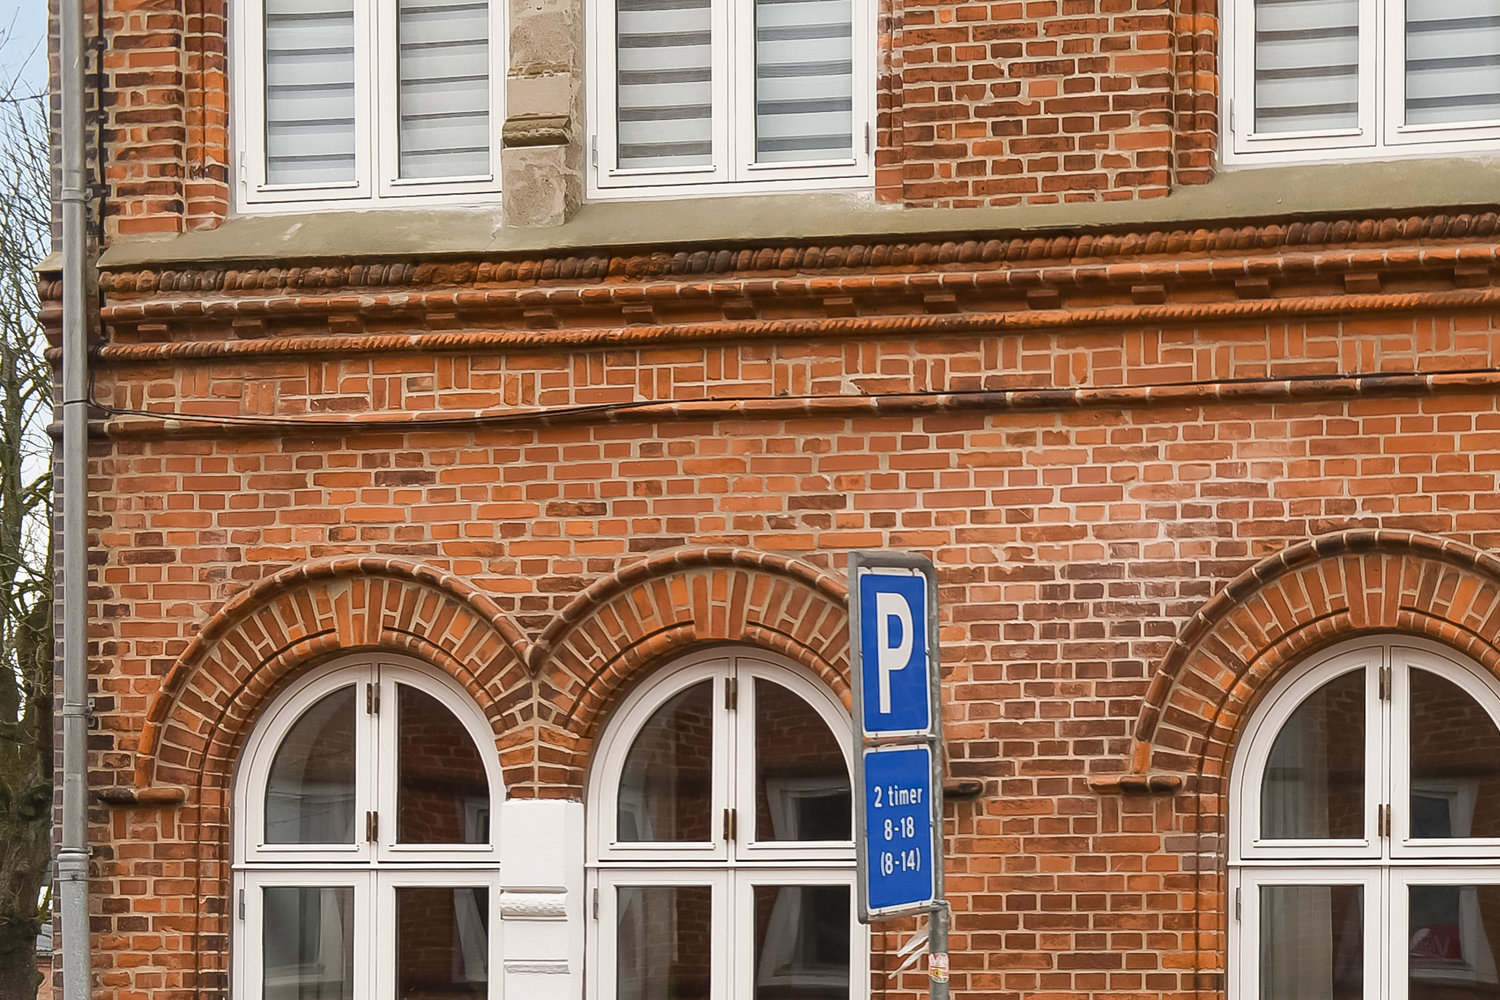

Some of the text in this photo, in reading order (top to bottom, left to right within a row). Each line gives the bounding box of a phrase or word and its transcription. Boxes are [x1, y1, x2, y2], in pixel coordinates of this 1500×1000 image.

[876, 592, 914, 715] P
[873, 784, 923, 808] 2 timer
[883, 816, 915, 841] 8-18
[880, 847, 921, 877] (8-14)
